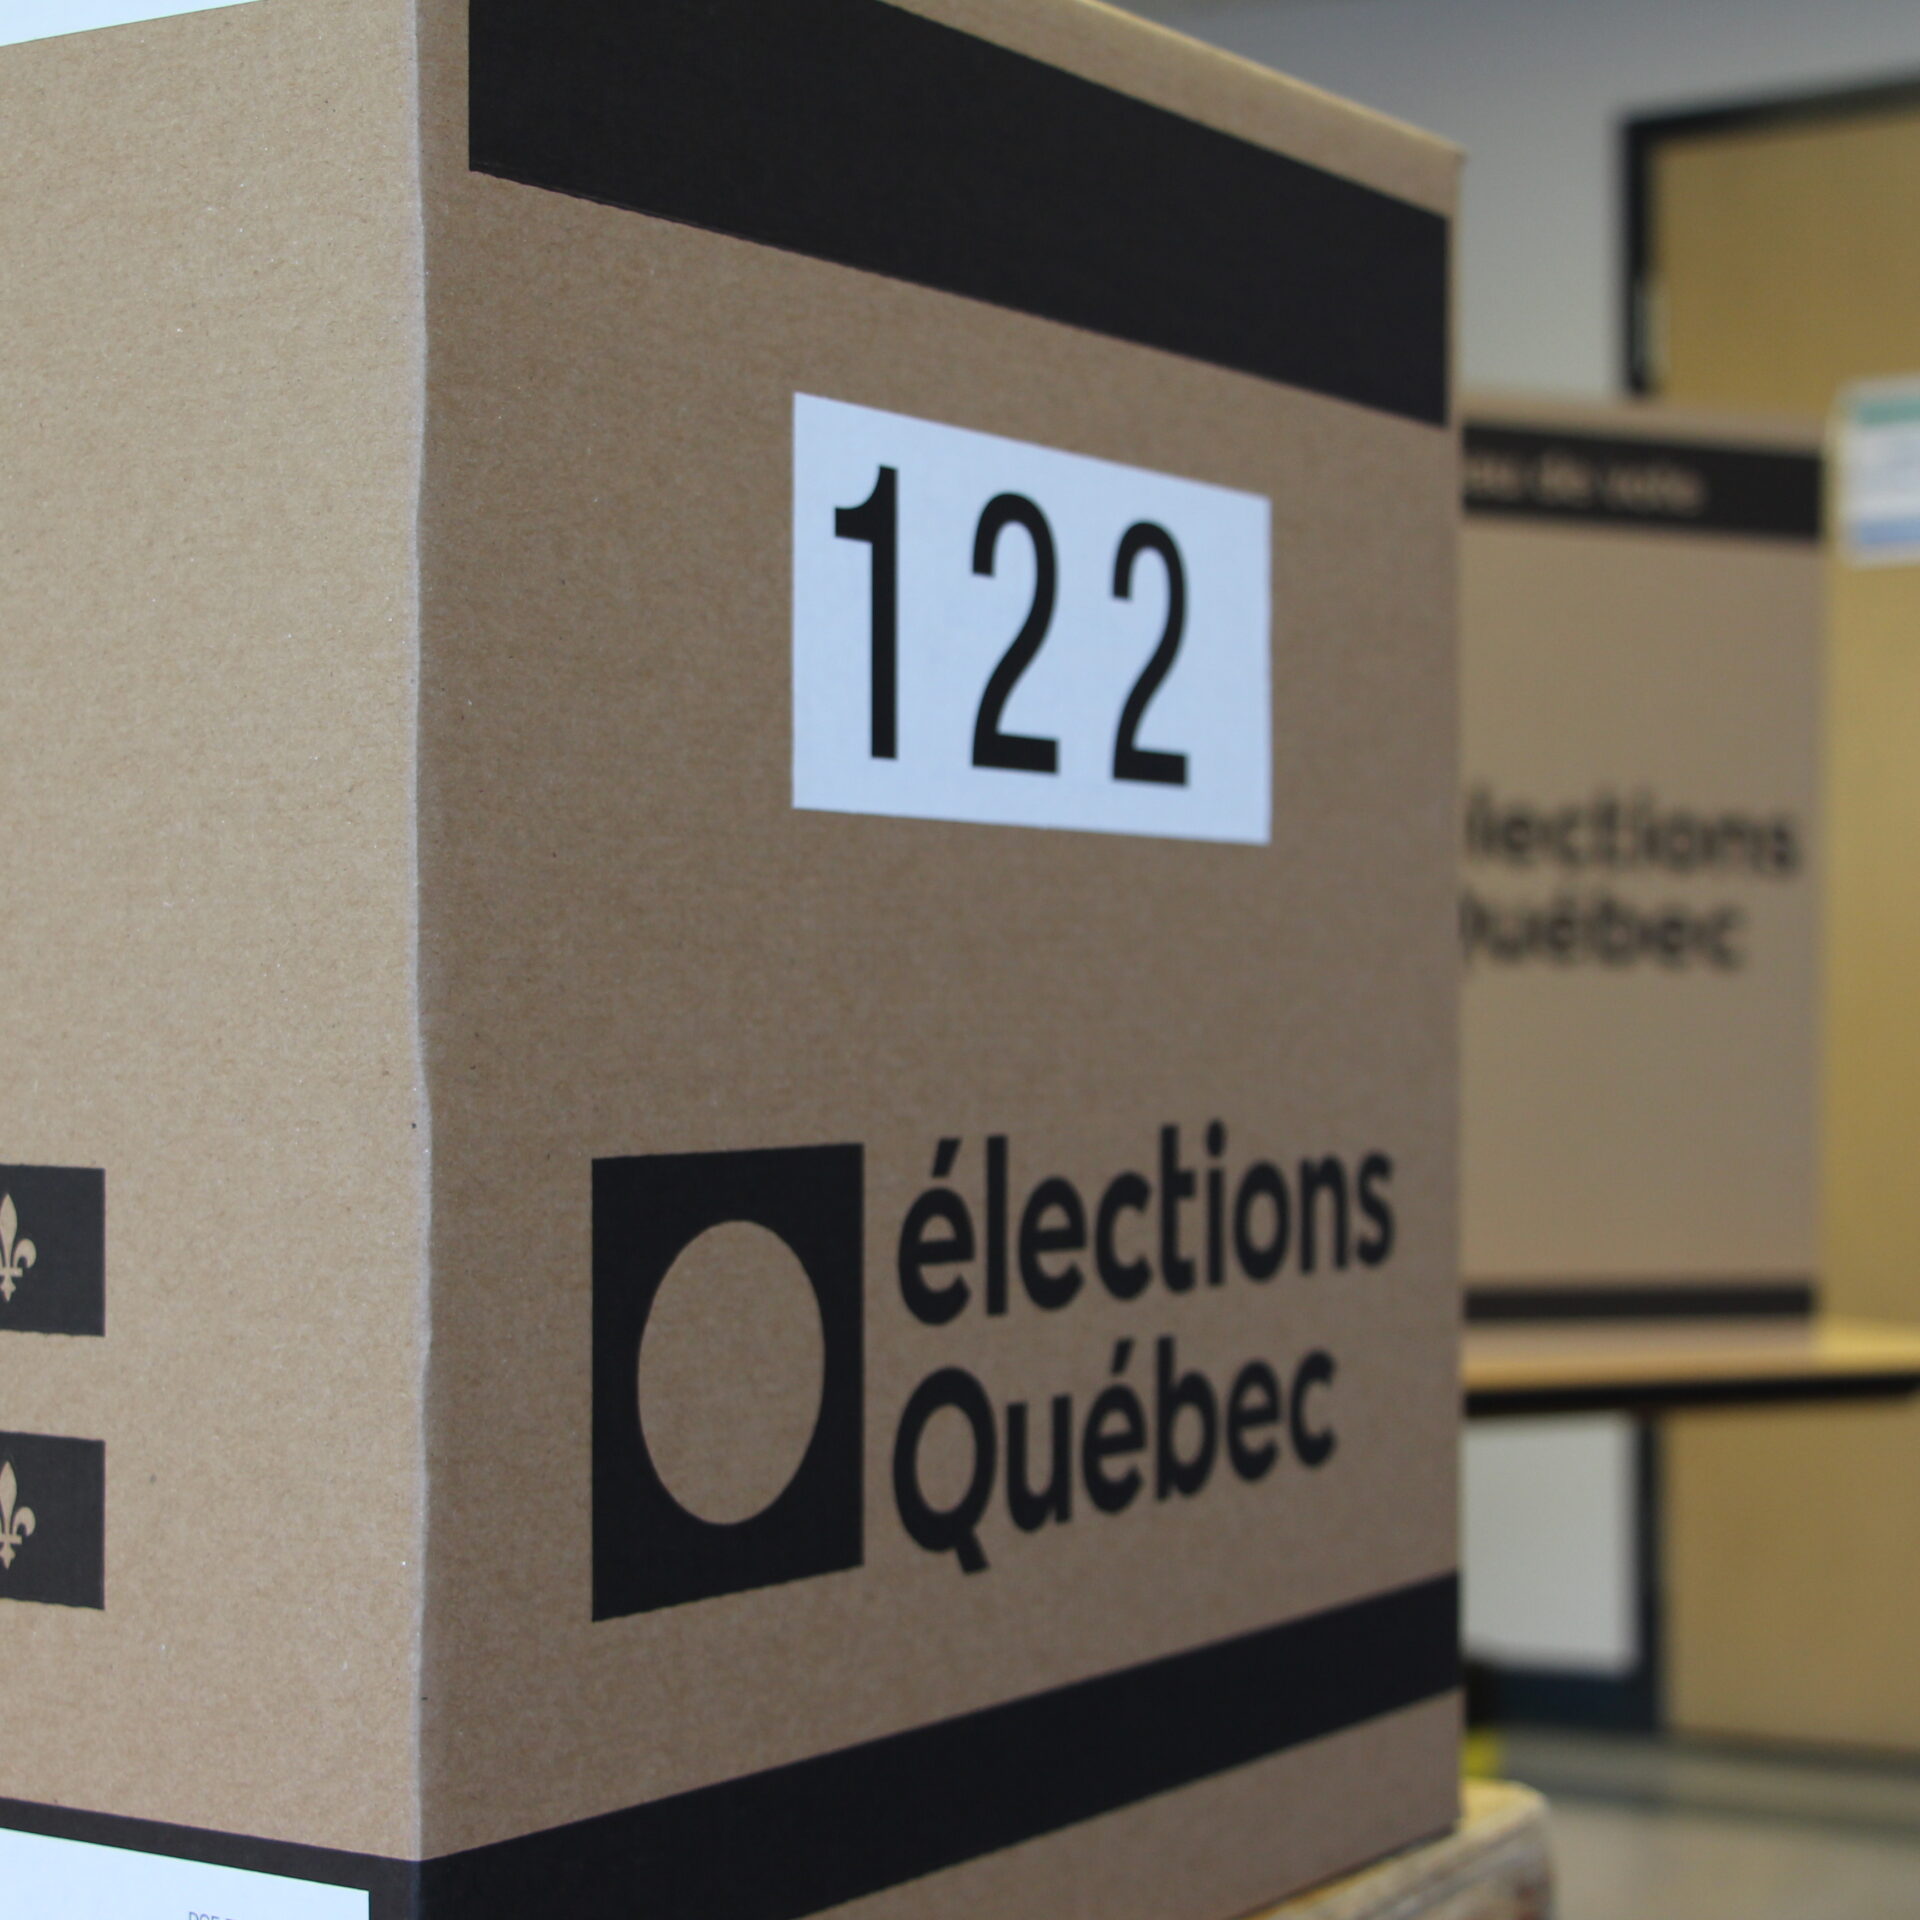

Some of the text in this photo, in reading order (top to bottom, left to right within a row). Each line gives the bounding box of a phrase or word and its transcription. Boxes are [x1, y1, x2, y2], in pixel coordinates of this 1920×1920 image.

[834, 464, 1188, 788] 122
[1465, 784, 1797, 880] lections
[896, 1118, 1396, 1328] élections
[891, 1334, 1338, 1577] Québec
